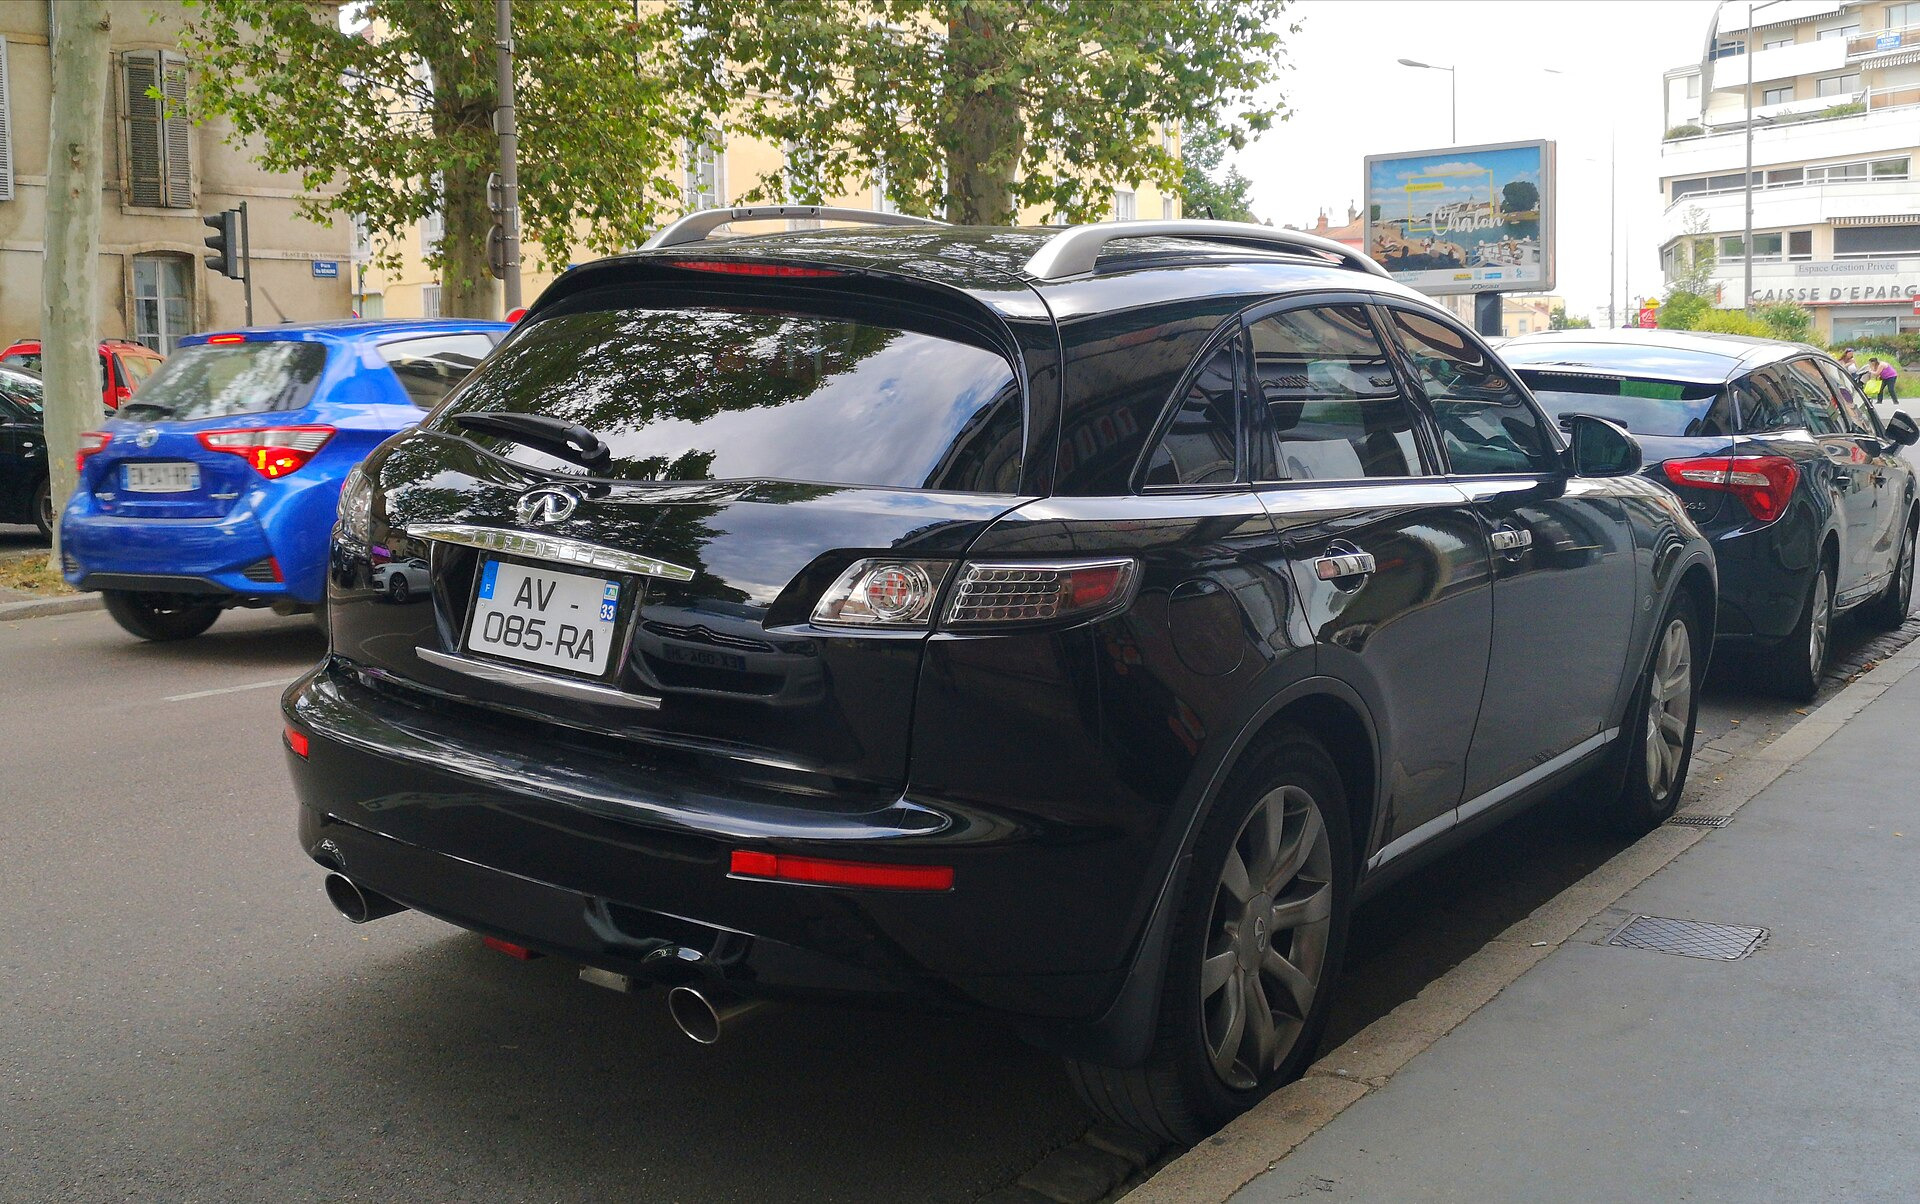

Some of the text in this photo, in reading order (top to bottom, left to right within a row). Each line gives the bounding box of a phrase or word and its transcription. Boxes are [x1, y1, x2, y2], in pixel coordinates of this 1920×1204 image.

[1799, 261, 1896, 273] Espace Gestion Privée
[1470, 282, 1500, 290] JCDecaux
[1752, 287, 1820, 301] CAISSE
[472, 530, 596, 564] INFINITI
[484, 583, 491, 593] F
[513, 576, 556, 611] AV
[600, 603, 614, 621] 33
[482, 611, 594, 662] 085-RA
